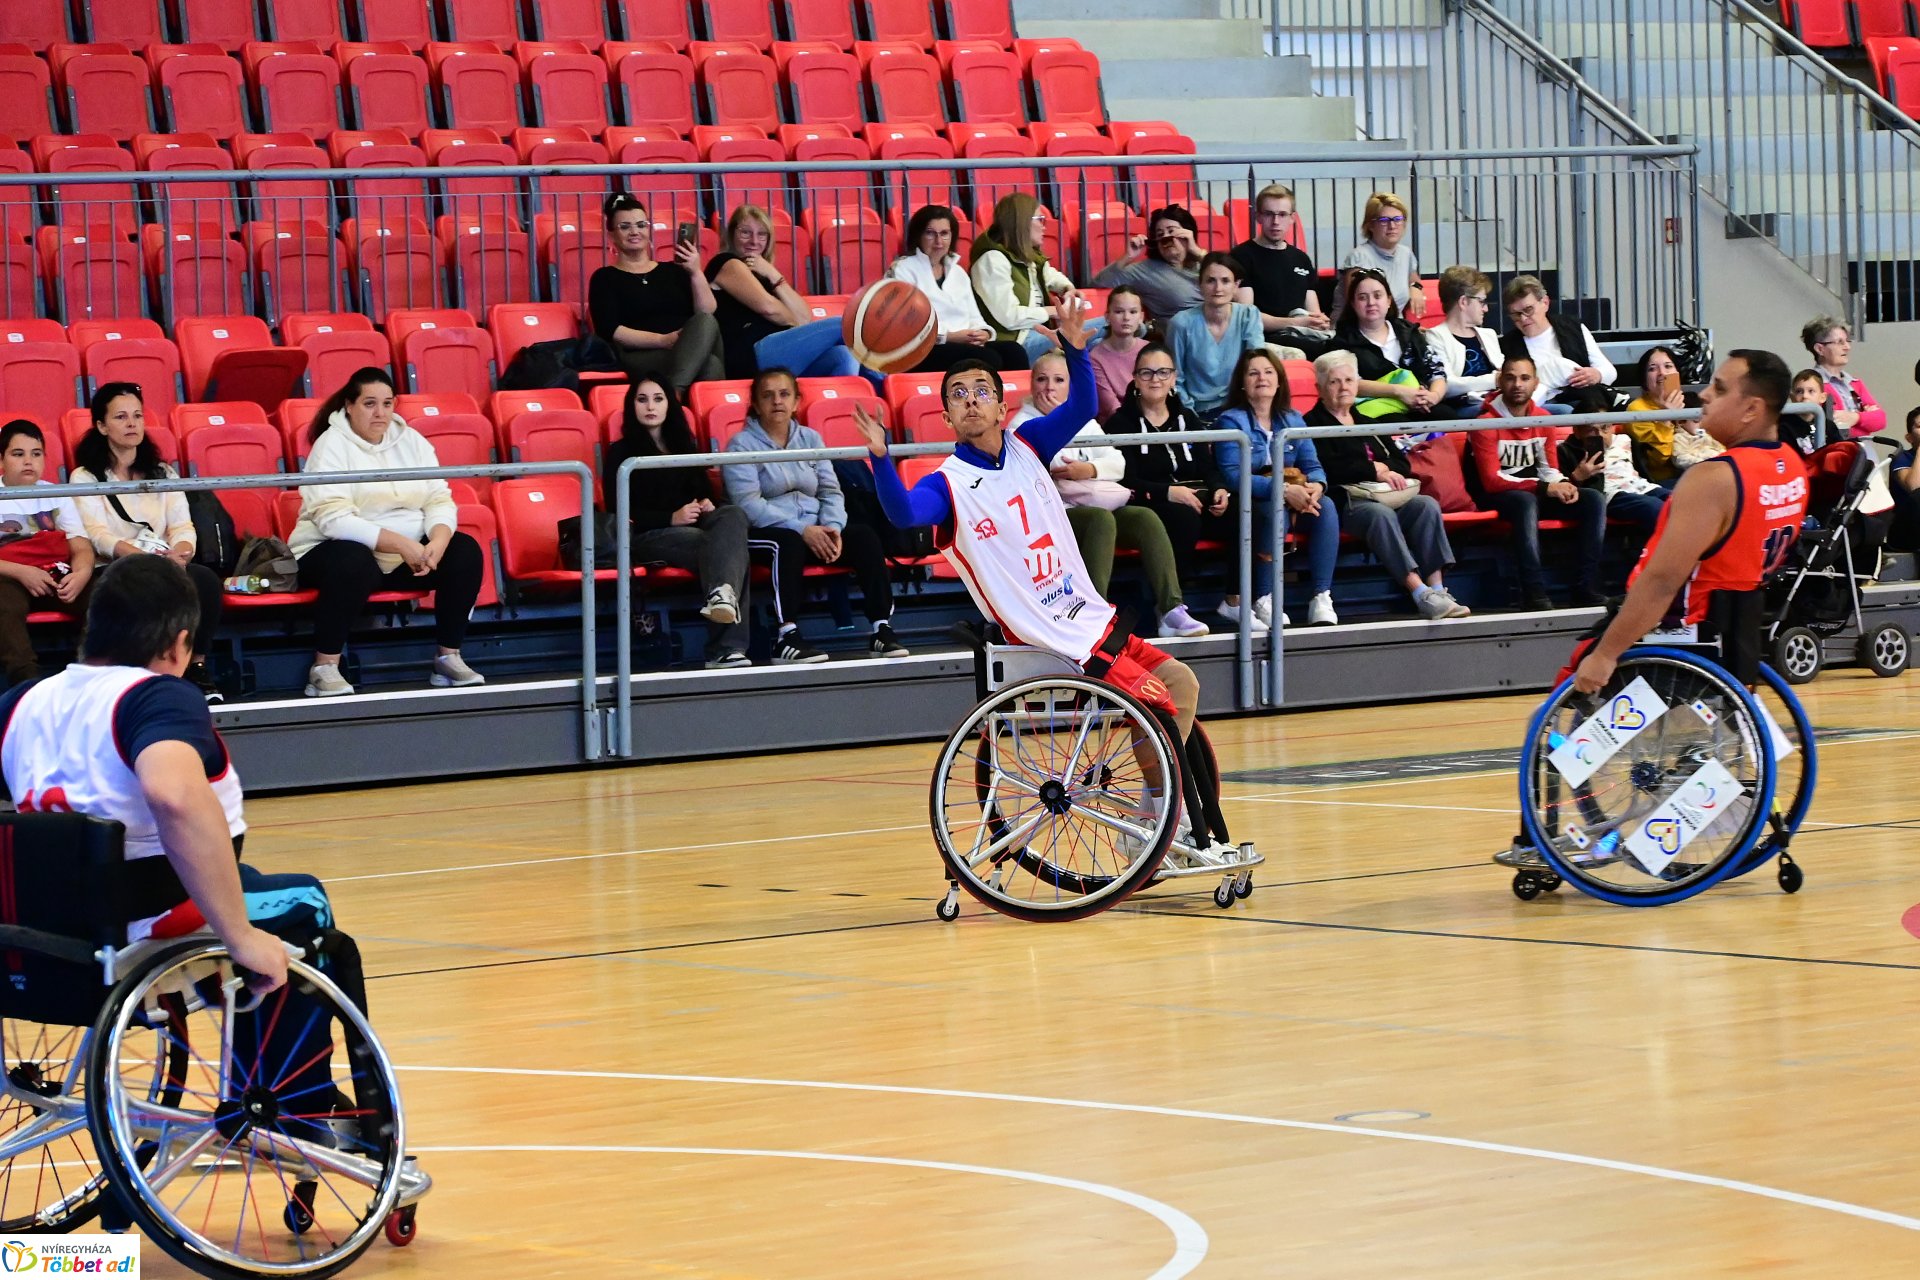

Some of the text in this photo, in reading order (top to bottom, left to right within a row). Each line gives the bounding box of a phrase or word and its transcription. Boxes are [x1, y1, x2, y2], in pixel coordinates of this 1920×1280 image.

[1759, 476, 1806, 505] SUPER
[1007, 494, 1031, 536] 7
[1035, 569, 1063, 591] marso
